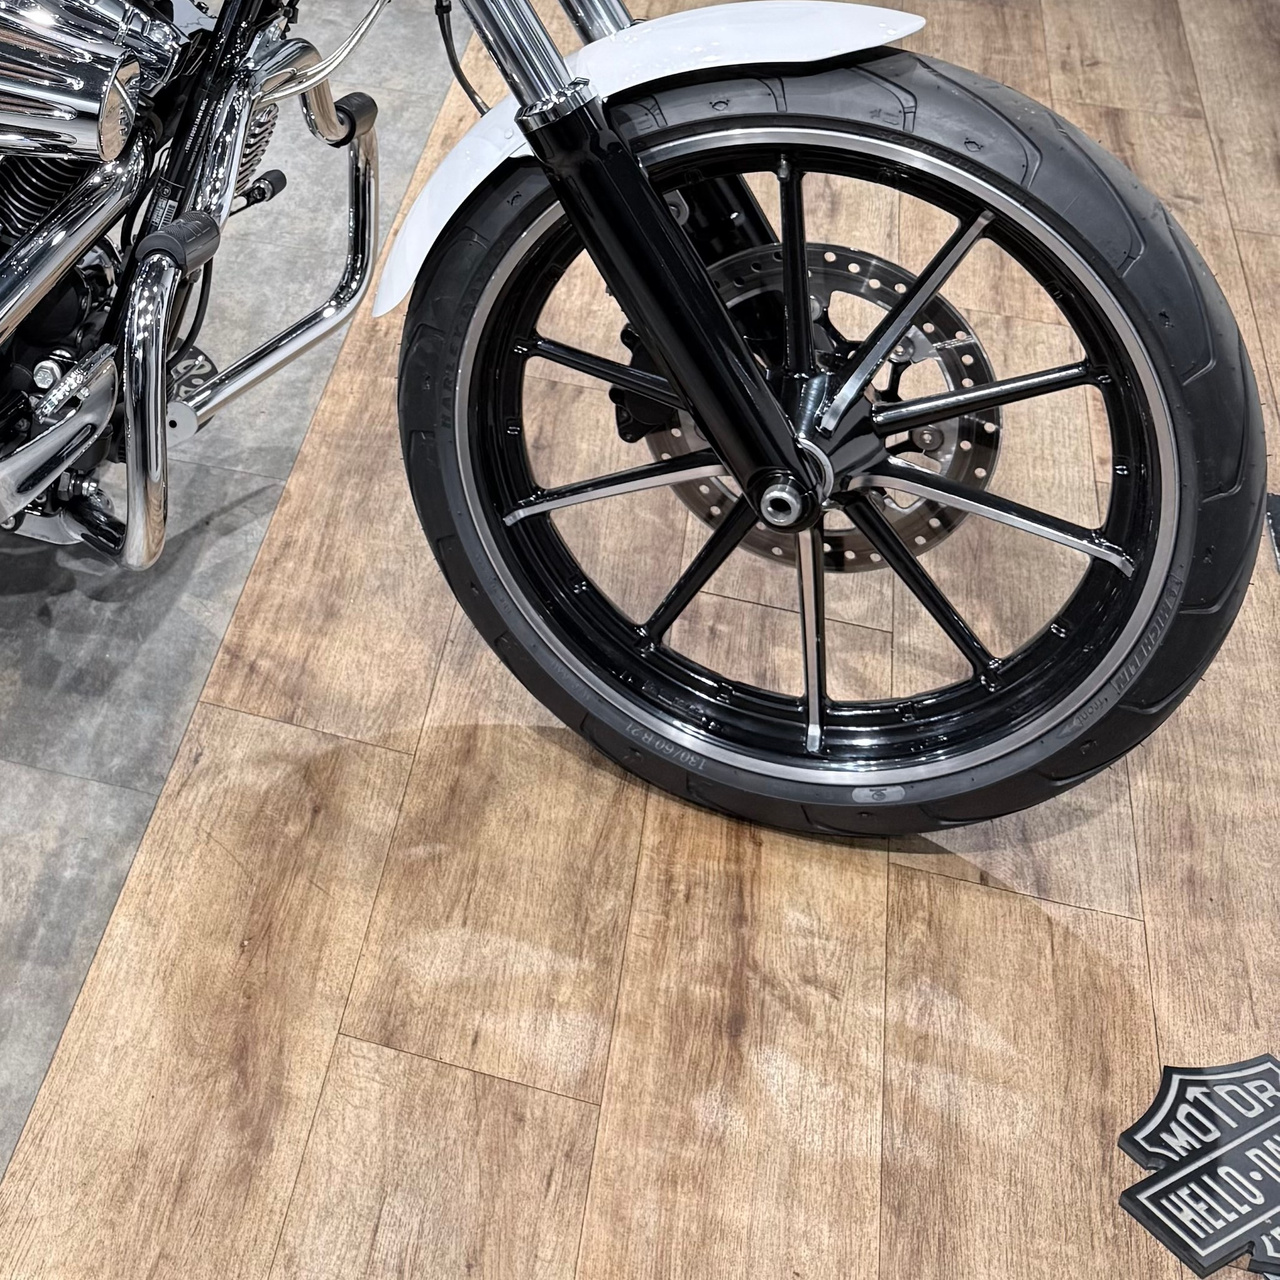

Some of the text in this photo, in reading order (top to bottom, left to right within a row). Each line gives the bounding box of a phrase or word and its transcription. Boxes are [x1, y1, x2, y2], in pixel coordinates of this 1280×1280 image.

[876, 129, 989, 180] SCORCHER
[1074, 697, 1107, 726] front
[652, 736, 707, 770] 130/60
[1160, 1080, 1280, 1157] MOTOR
[1160, 1165, 1265, 1239] HELLO
